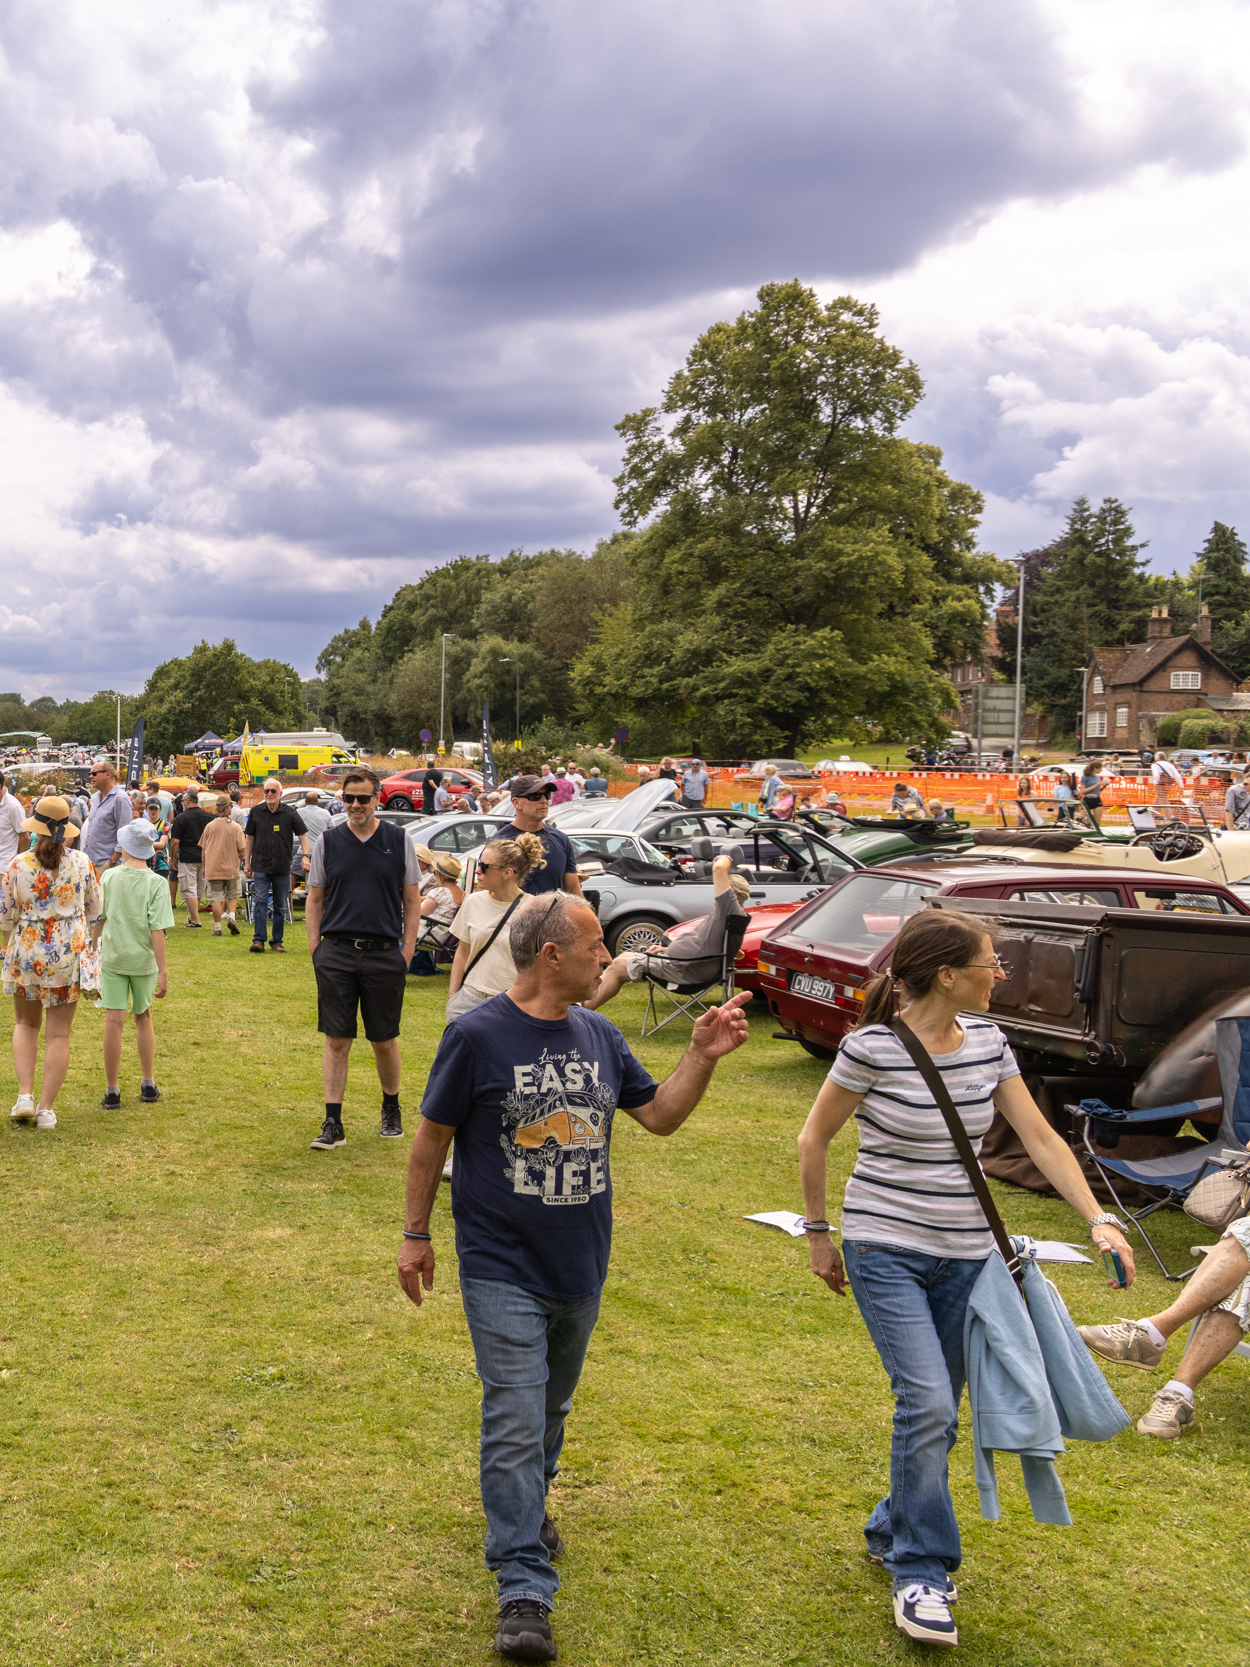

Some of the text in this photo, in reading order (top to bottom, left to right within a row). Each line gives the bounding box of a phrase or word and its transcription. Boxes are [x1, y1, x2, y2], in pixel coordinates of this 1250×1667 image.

[131, 737, 139, 781] PINE
[794, 975, 835, 999] CVU 997Y
[538, 1048, 581, 1066] Living the
[513, 1061, 600, 1094] EASY
[513, 1158, 606, 1195] LIFE
